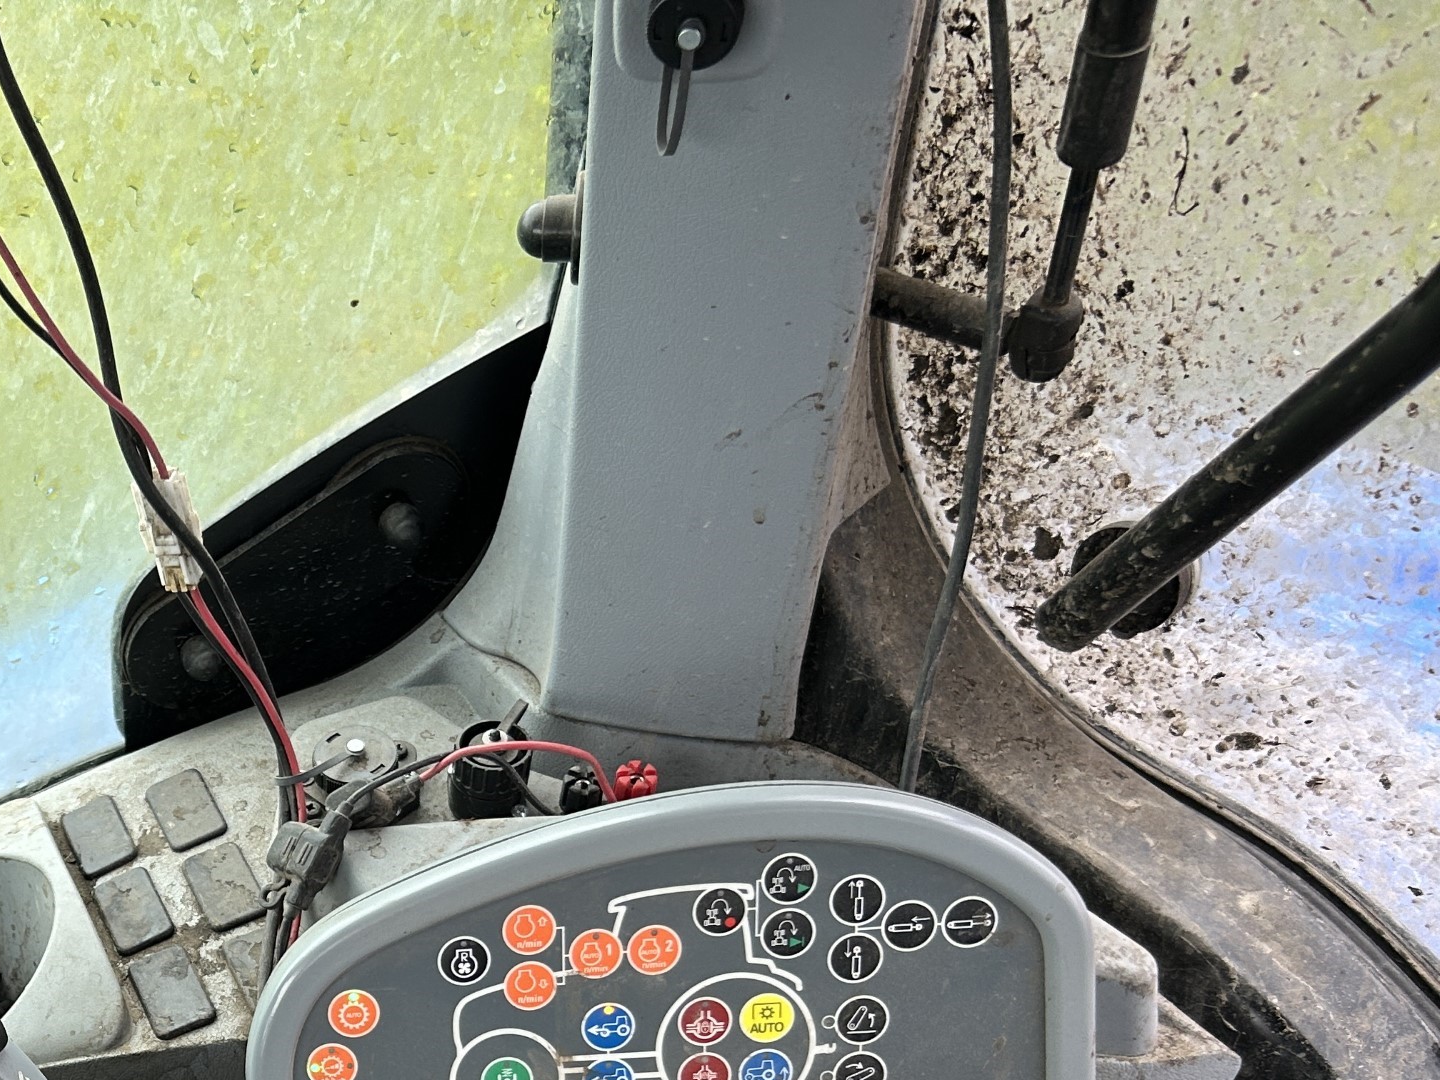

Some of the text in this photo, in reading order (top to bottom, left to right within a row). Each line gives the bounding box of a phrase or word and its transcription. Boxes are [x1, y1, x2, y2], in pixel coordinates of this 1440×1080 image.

[516, 939, 543, 950] n/min
[605, 943, 612, 956] 1
[665, 939, 674, 953] 2
[460, 952, 469, 962] R
[517, 994, 544, 1004] n/min
[750, 1021, 784, 1034] AUTO
